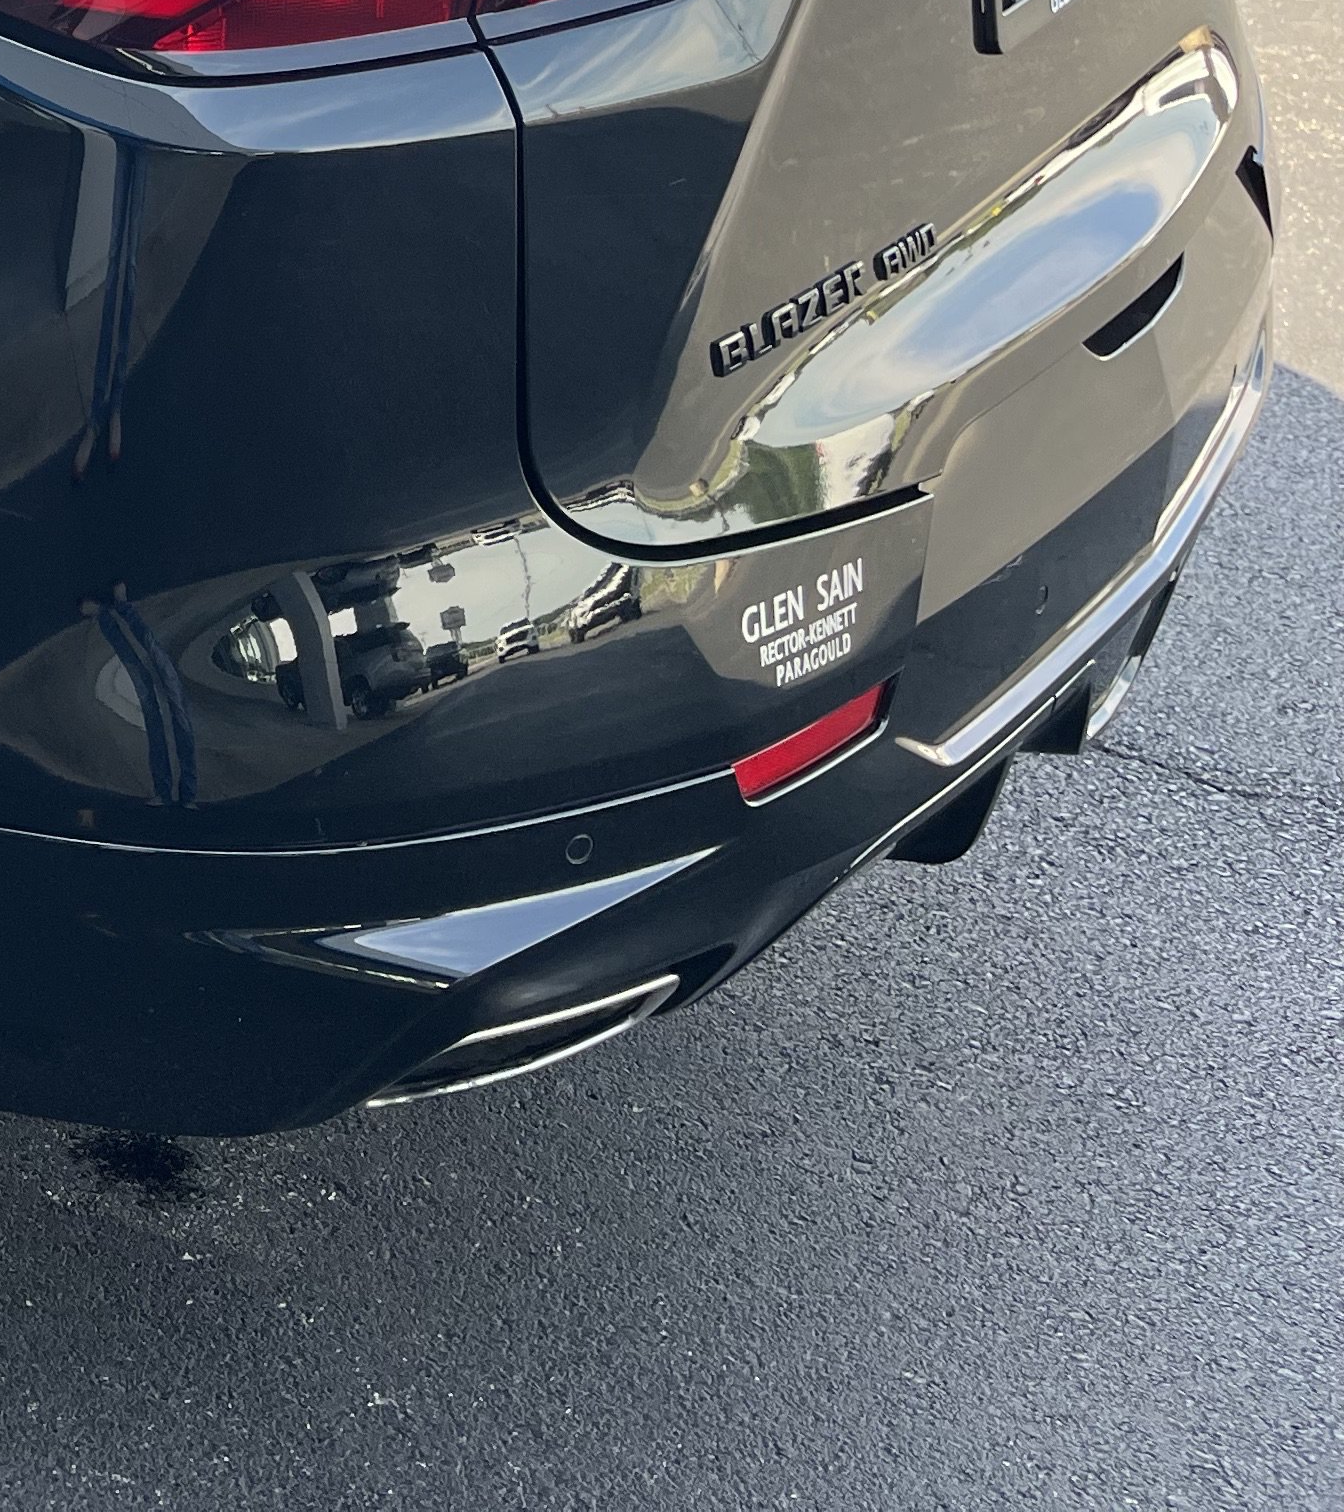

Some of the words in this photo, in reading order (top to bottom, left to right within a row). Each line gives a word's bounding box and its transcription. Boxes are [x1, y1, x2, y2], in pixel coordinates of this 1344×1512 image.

[712, 259, 866, 377] BLAZER
[873, 222, 938, 281] AWD
[741, 584, 805, 643] GLEN
[816, 557, 864, 612] SAIN
[759, 601, 858, 668] RECTOR-KENNETT
[775, 632, 852, 687] PARAGOULD
